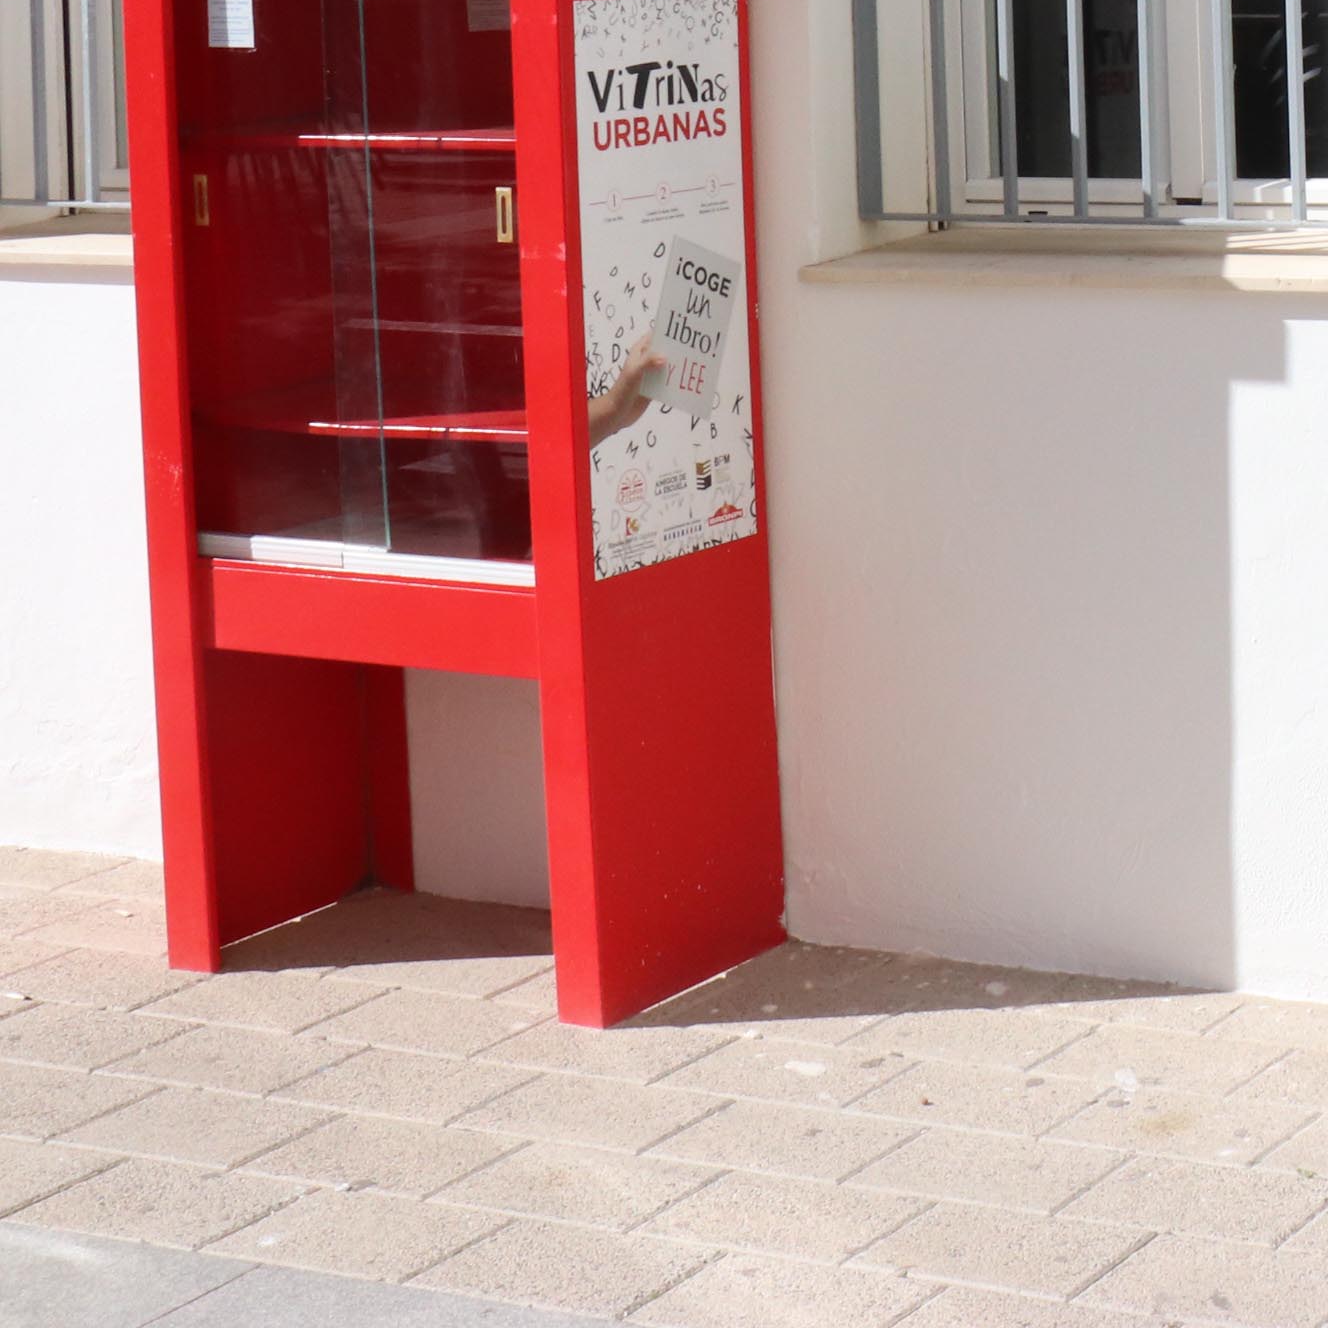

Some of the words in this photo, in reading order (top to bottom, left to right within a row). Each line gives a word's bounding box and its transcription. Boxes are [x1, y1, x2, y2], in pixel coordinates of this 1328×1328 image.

[593, 107, 727, 151] URBANAS
[659, 186, 667, 200] 2
[686, 287, 712, 320] un
[664, 310, 721, 358] libro!
[679, 357, 706, 395] LEE
